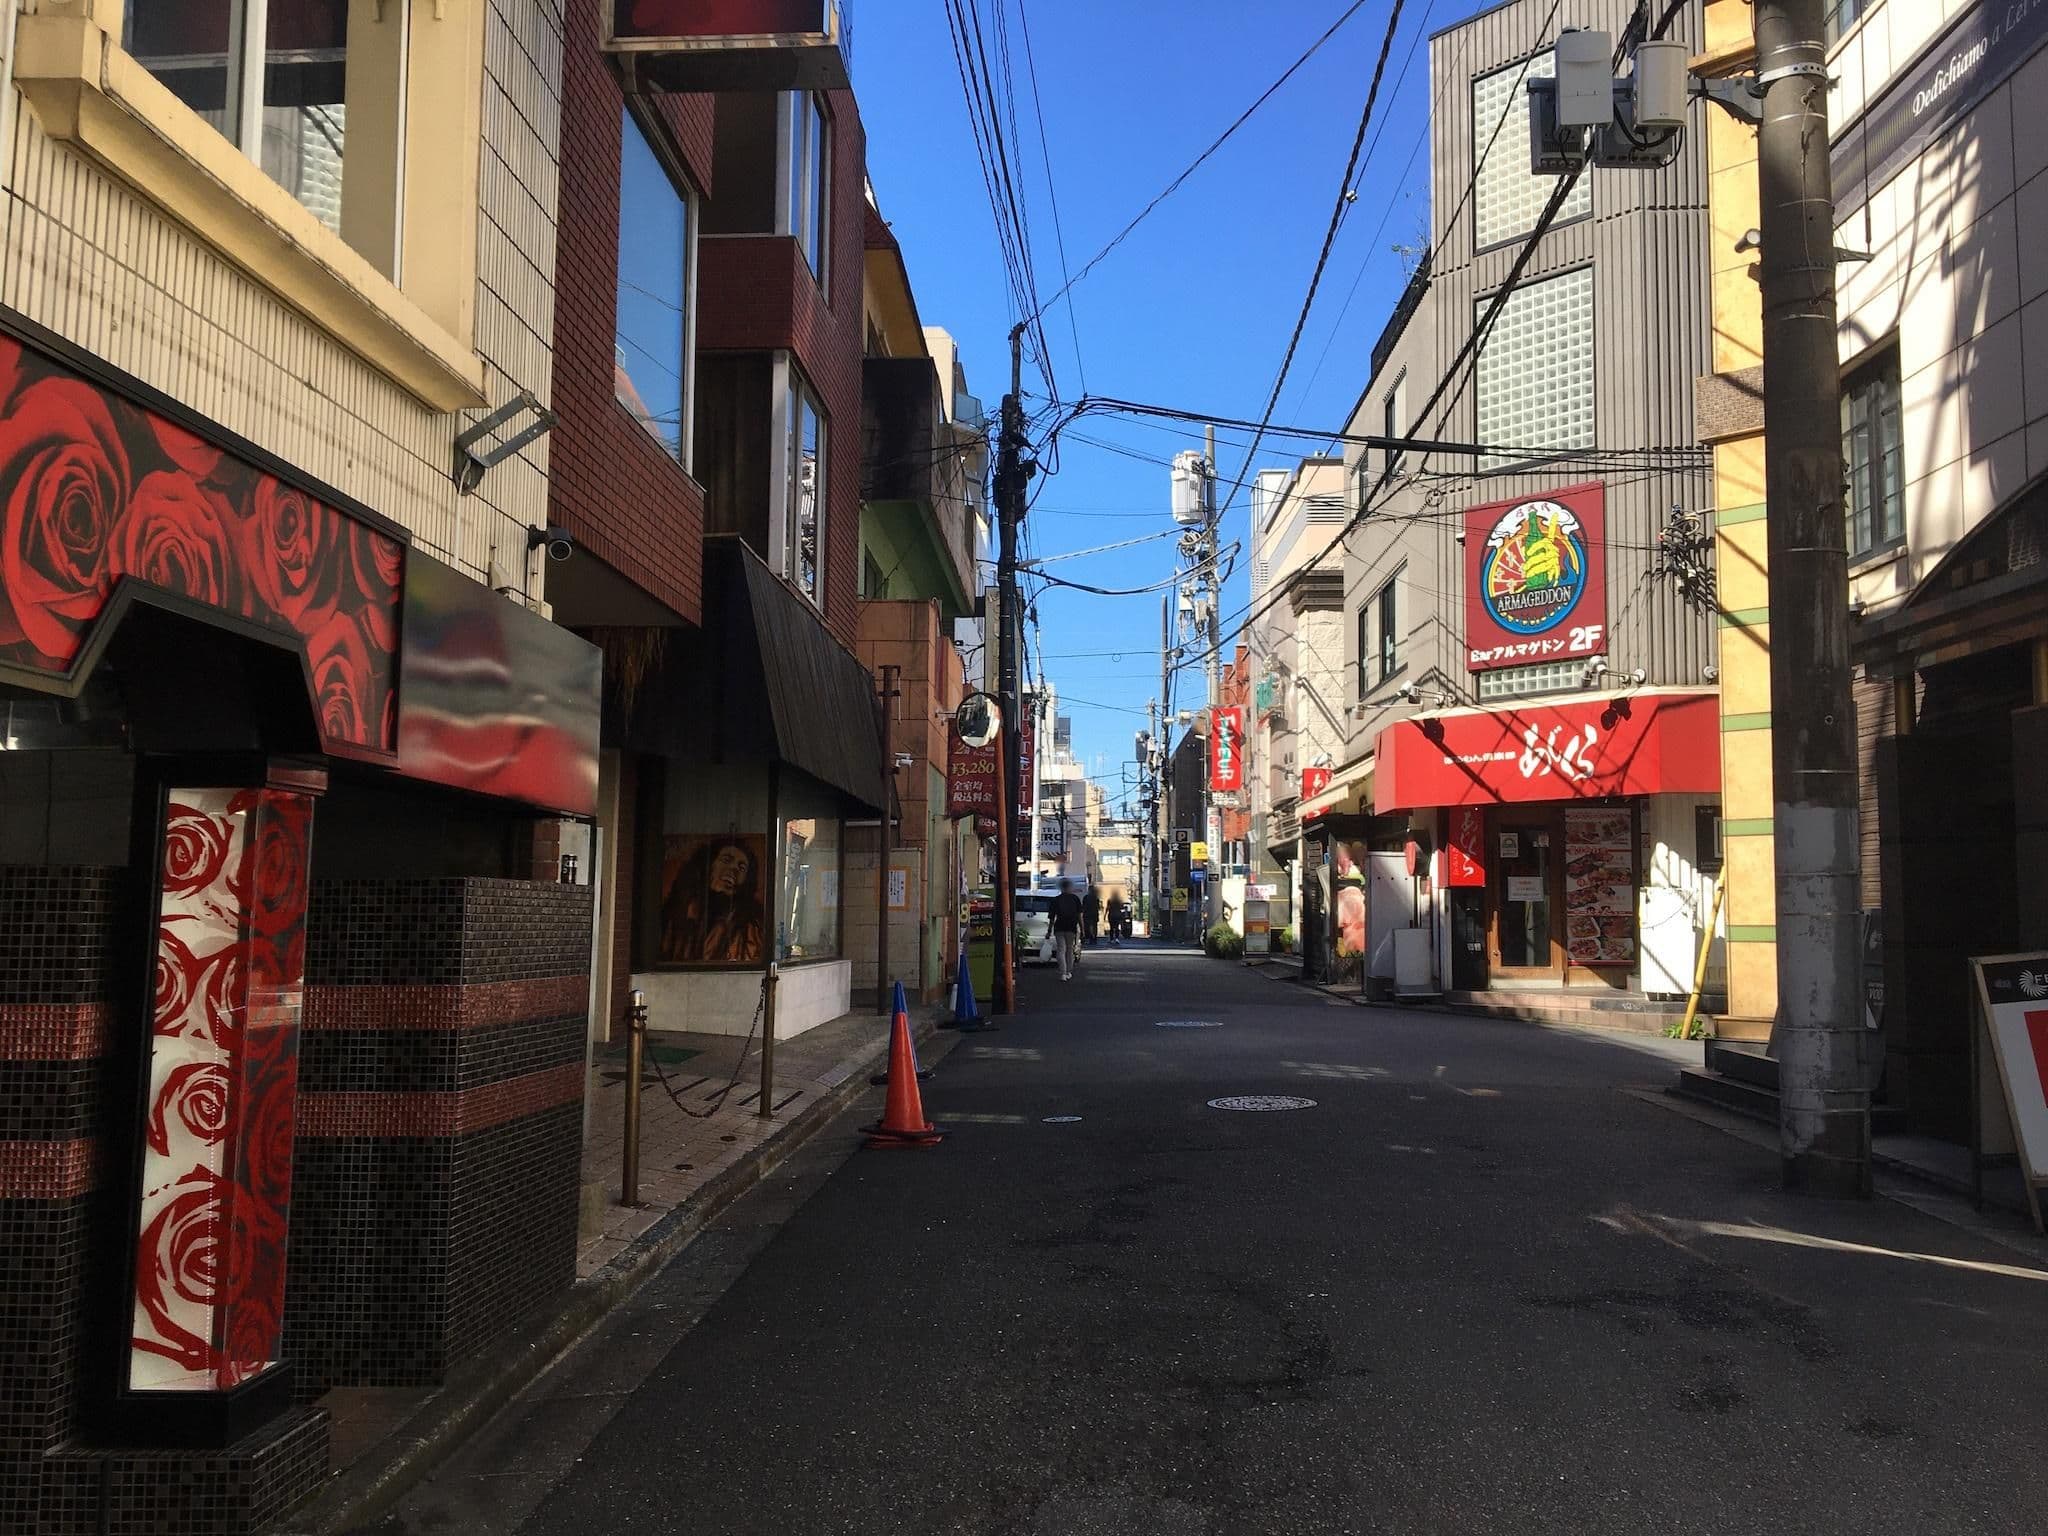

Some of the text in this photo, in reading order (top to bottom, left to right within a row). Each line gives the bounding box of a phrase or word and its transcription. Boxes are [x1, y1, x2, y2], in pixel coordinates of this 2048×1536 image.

[1912, 36, 1988, 117] Dedichiamo
[1497, 586, 1572, 612] ARMAGEDDON
[1568, 625, 1603, 651] 2F
[1518, 723, 1598, 782] あじくら
[952, 759, 995, 777] ¥3,280
[953, 780, 993, 791] 全室均一
[953, 791, 993, 802] 税込料金
